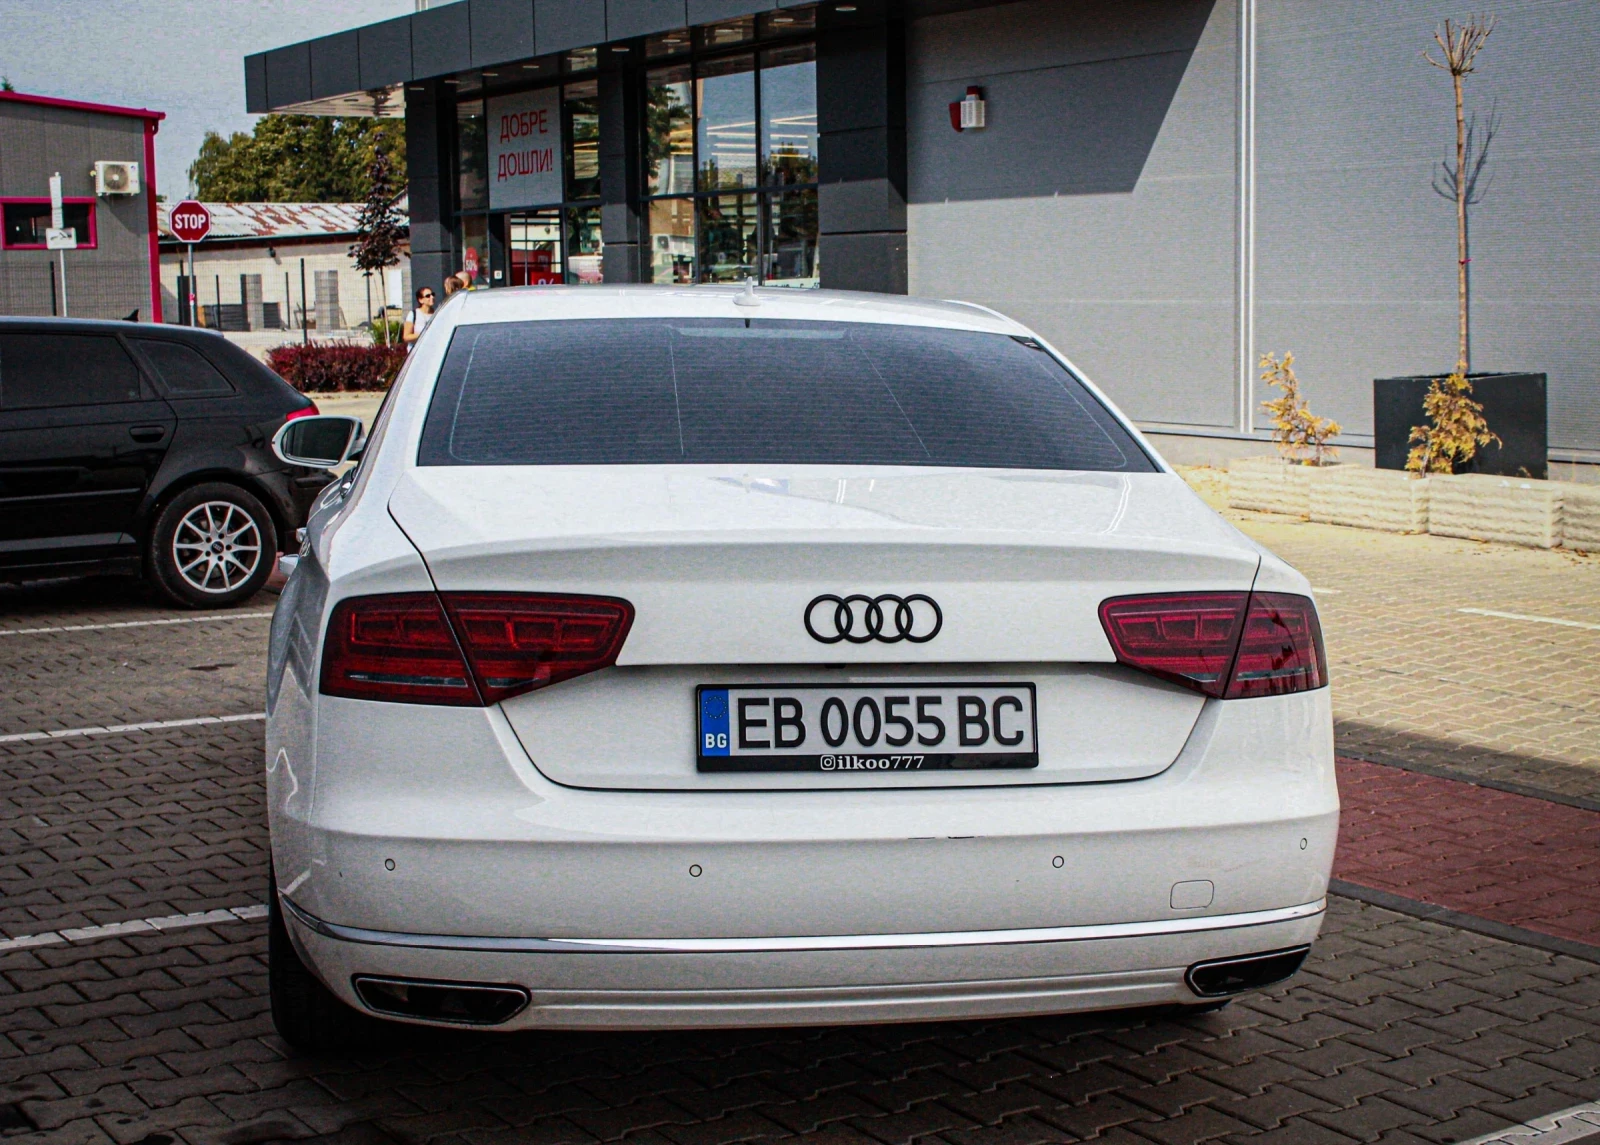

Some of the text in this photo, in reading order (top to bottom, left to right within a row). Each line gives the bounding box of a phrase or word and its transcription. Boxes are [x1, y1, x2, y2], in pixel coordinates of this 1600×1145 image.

[500, 109, 548, 144] ДОБРЕ
[498, 148, 553, 182] ДОШЛИ!
[174, 213, 206, 229] STOP
[737, 695, 1024, 749] EB 0055 BC
[705, 733, 727, 749] BG
[837, 755, 925, 770] ilkoo777
